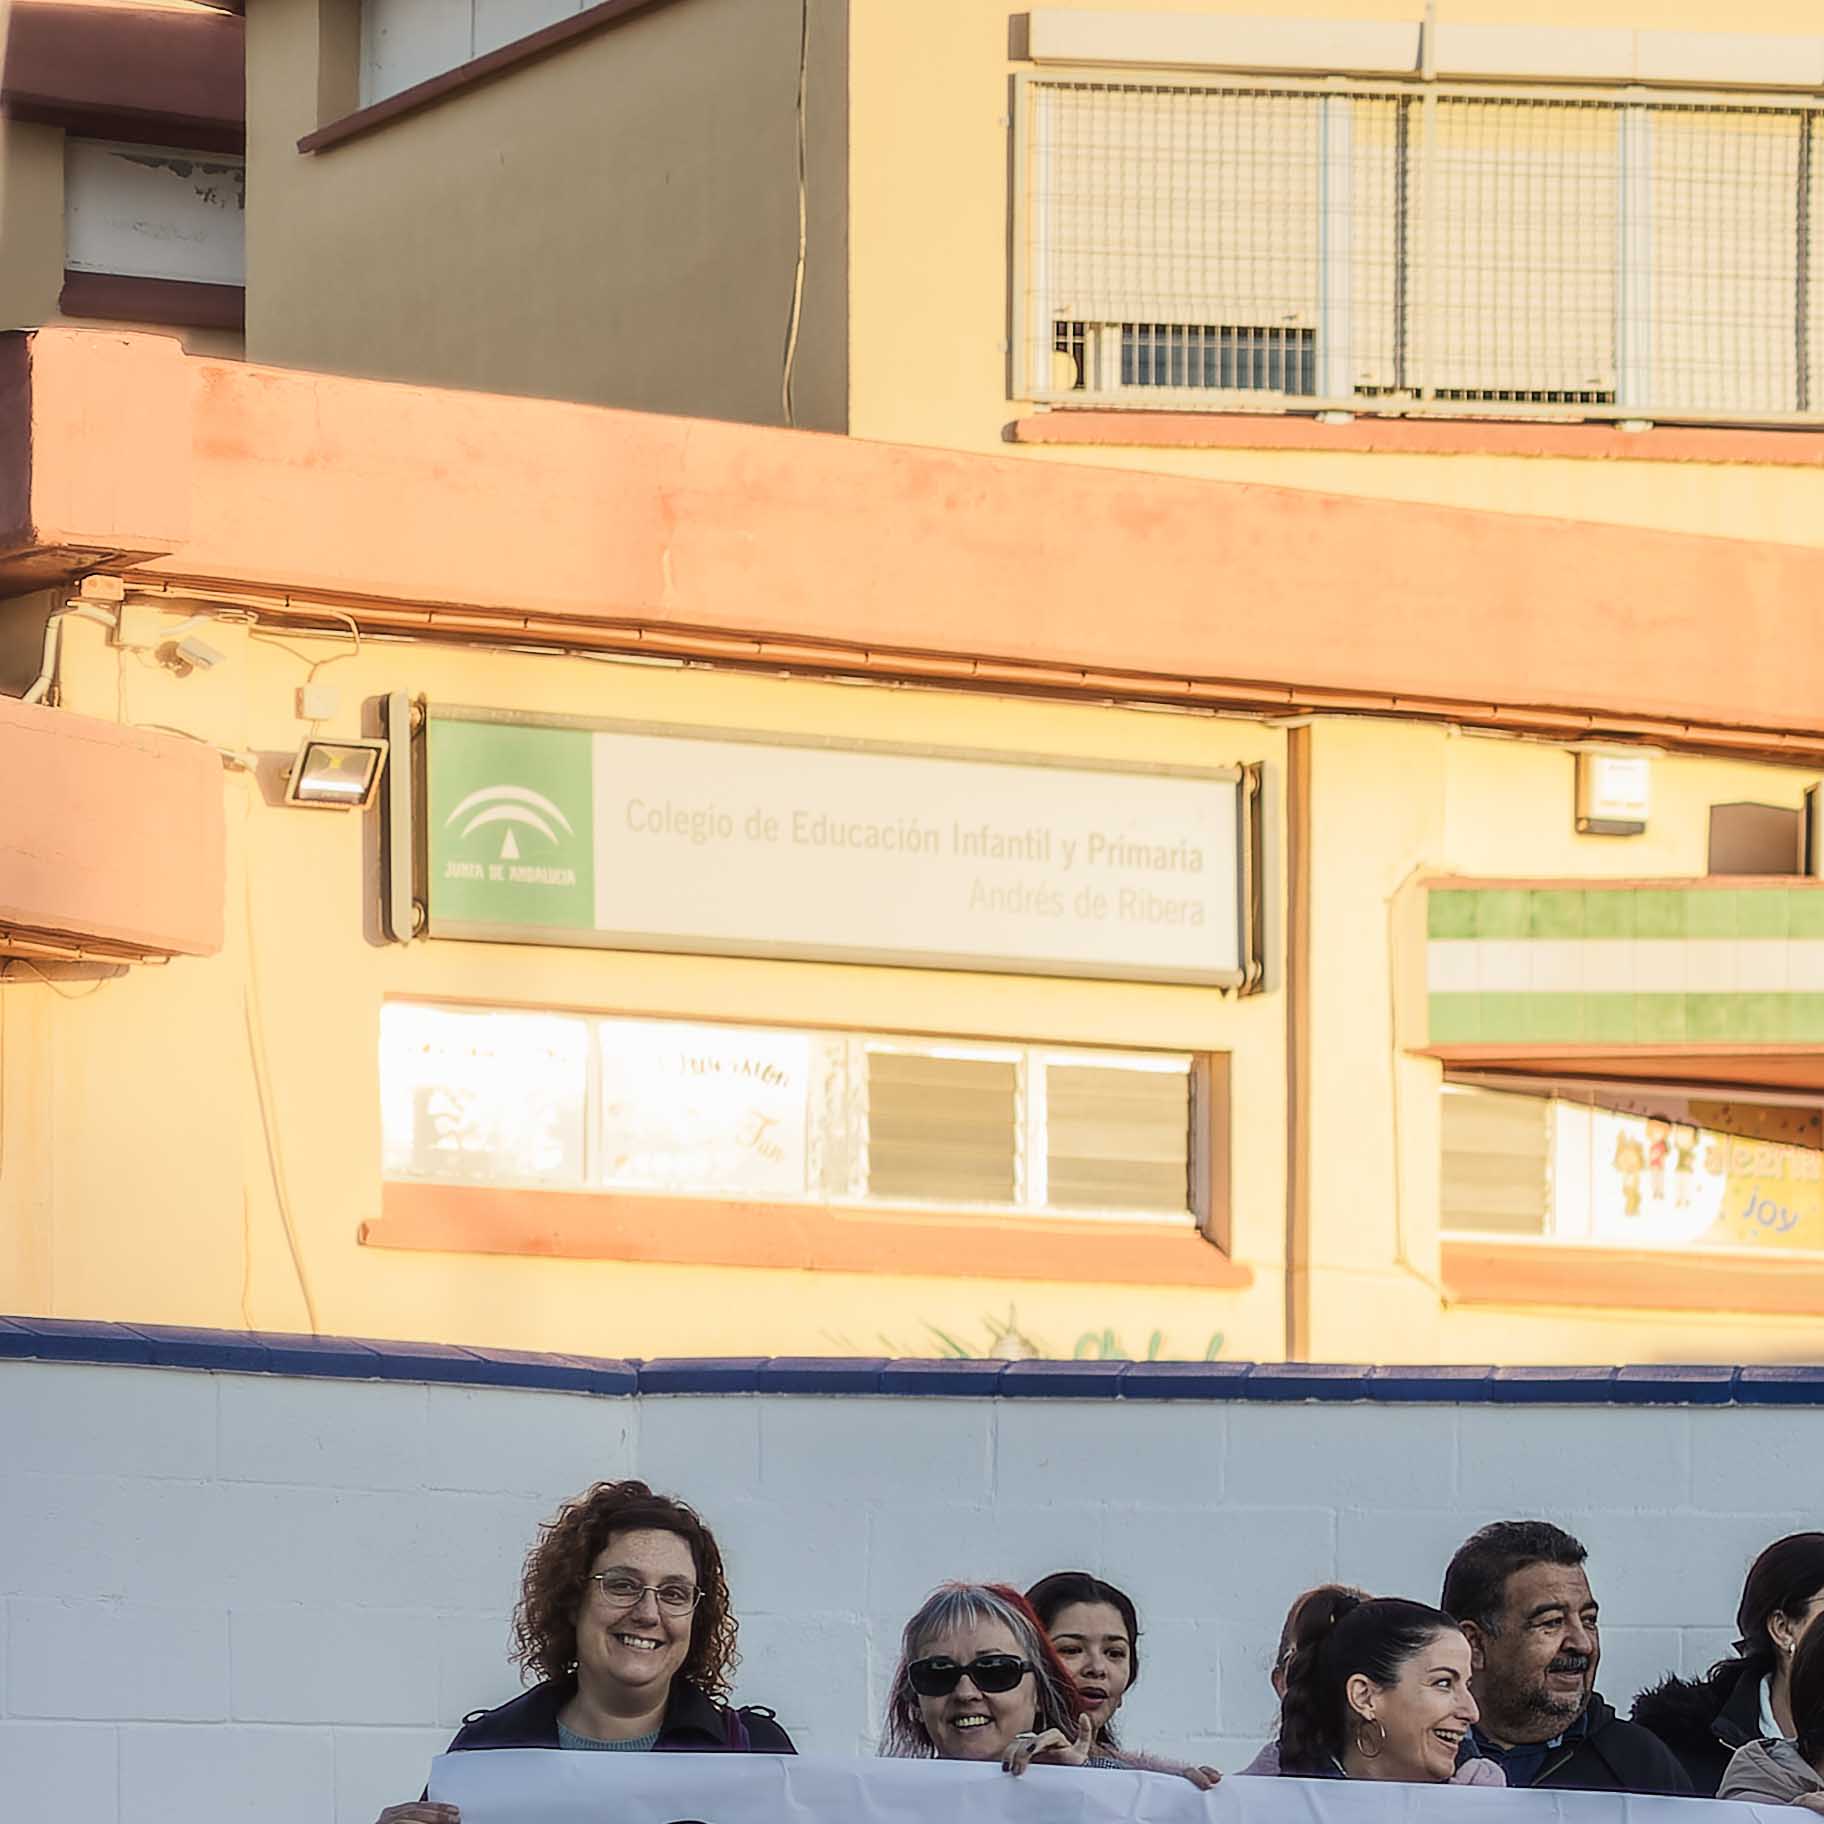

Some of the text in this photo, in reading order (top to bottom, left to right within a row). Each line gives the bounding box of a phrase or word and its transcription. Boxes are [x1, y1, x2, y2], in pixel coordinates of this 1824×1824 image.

[626, 797, 1204, 874] Colegio de Educación Infantil y Primaria
[444, 859, 485, 880] JUNTA
[968, 874, 1206, 927] Andrés de Ribera
[1743, 1184, 1799, 1233] joy
